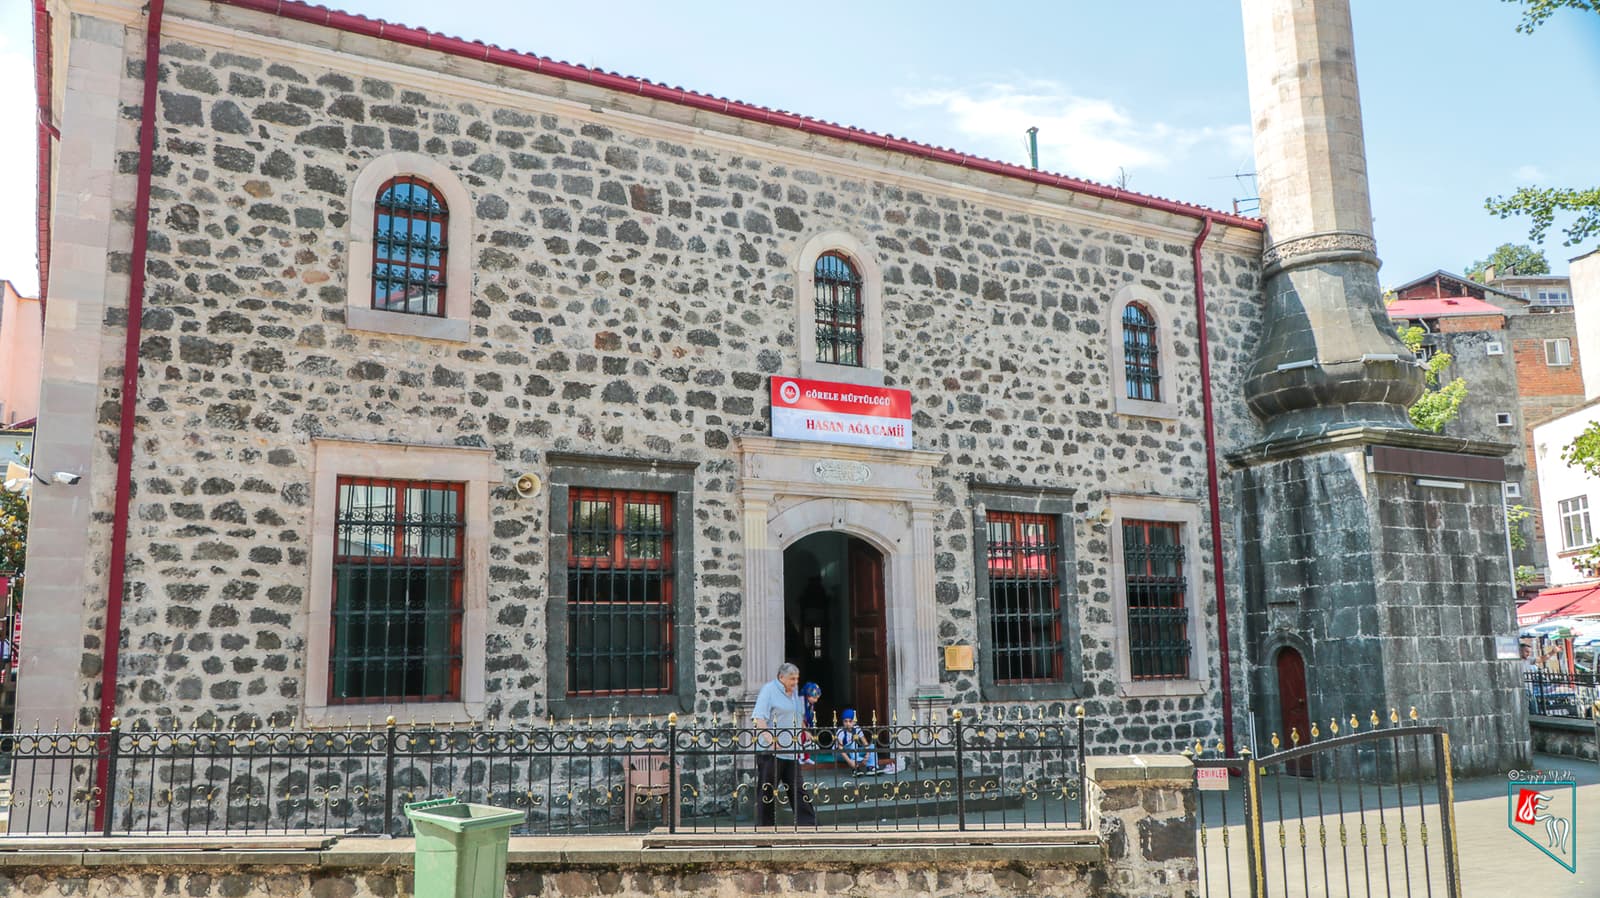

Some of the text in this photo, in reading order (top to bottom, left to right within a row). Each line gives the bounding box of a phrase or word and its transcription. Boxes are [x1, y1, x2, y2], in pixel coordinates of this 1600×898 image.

[805, 389, 890, 406] GÖRELE MÜFTÜLÜĞÜ
[806, 418, 905, 437] HASAN AĞA CAMİİ
